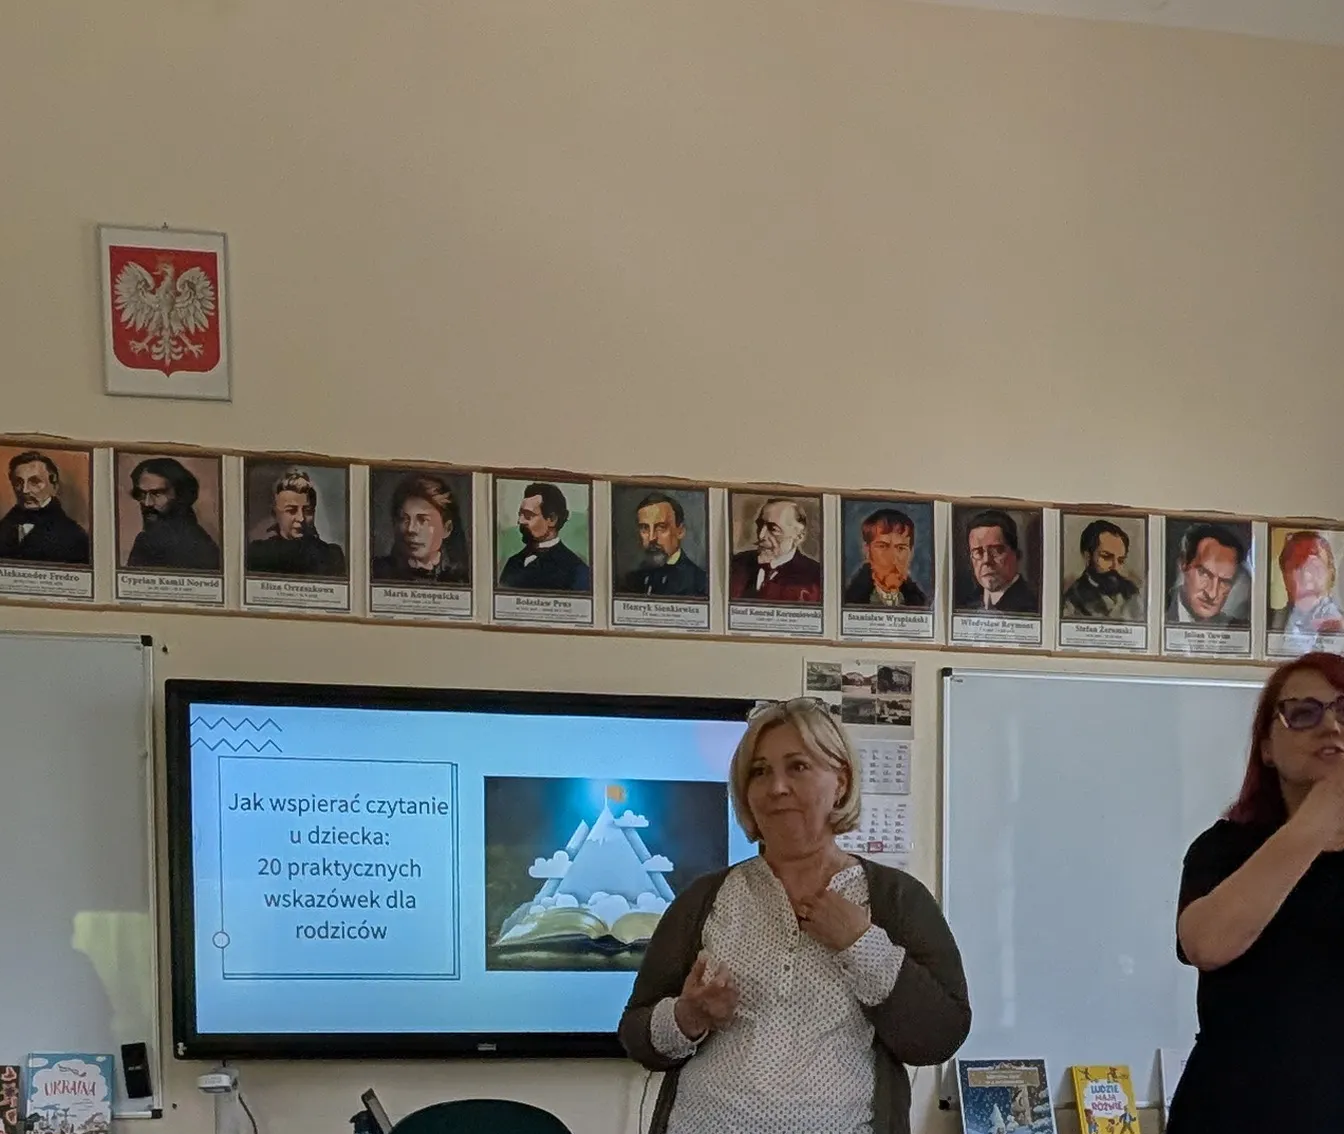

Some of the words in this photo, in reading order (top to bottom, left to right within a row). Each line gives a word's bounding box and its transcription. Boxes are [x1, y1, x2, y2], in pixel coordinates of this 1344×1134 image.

[49, 571, 81, 582] Fredro
[120, 575, 156, 587] Cyprian
[157, 576, 186, 587] Kamil
[187, 578, 220, 588] Norwid
[260, 581, 281, 591] Eliza
[283, 583, 335, 594] Orzeszkowa
[383, 589, 409, 599] Maria
[410, 591, 460, 601] Konopnicka
[552, 599, 572, 608] Prus
[622, 603, 652, 613] Henryk
[653, 604, 700, 614] Sienkiewicz
[749, 608, 775, 617] Konrad
[1001, 620, 1034, 630] Reymont
[1075, 624, 1098, 634] Stefan
[228, 792, 265, 812] Jak
[268, 793, 361, 817] wspierać
[366, 796, 449, 819] czytanie
[290, 829, 302, 844] u
[307, 825, 391, 846] dziecka:
[257, 858, 282, 876] 20
[288, 857, 422, 882] praktycznych
[264, 888, 381, 909] wskazówek
[386, 889, 416, 909] dla
[296, 919, 388, 940] rodziców
[43, 1079, 97, 1098] UKRAINA
[1090, 1084, 1120, 1094] LUDZIE
